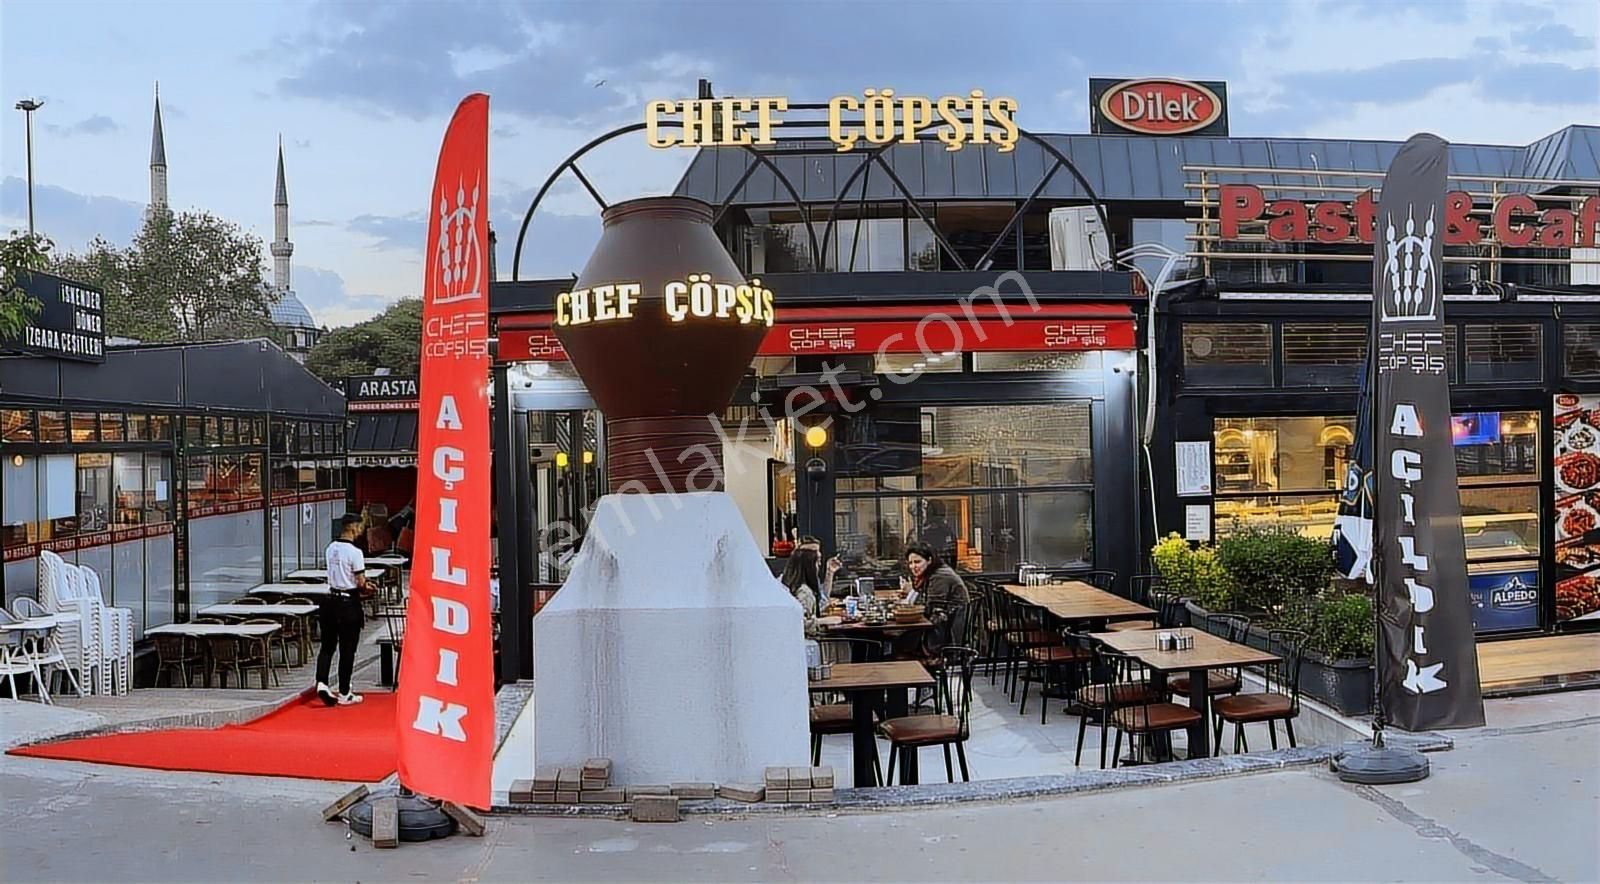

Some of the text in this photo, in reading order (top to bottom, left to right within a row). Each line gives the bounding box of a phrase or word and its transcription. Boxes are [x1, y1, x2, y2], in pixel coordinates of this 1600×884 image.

[1122, 91, 1199, 121] Dilek
[645, 88, 1019, 152] CHEF ÇÖPŞİŞ
[1219, 184, 1377, 244] Past
[61, 284, 101, 310] İSKENDER
[556, 273, 775, 327] CHEF ÇÖPŞİŞ
[25, 326, 60, 349] IZGARA
[426, 313, 486, 338] CHEF
[789, 328, 855, 339] CHEF
[1044, 325, 1106, 335] CHEF
[528, 335, 560, 346] CH
[1380, 333, 1443, 352] CHEF
[359, 380, 417, 396] ARASTA
[1390, 403, 1447, 694] AÇILDIK
[413, 395, 470, 742] AÇILDIK
[1494, 590, 1537, 603] ALPEDO
